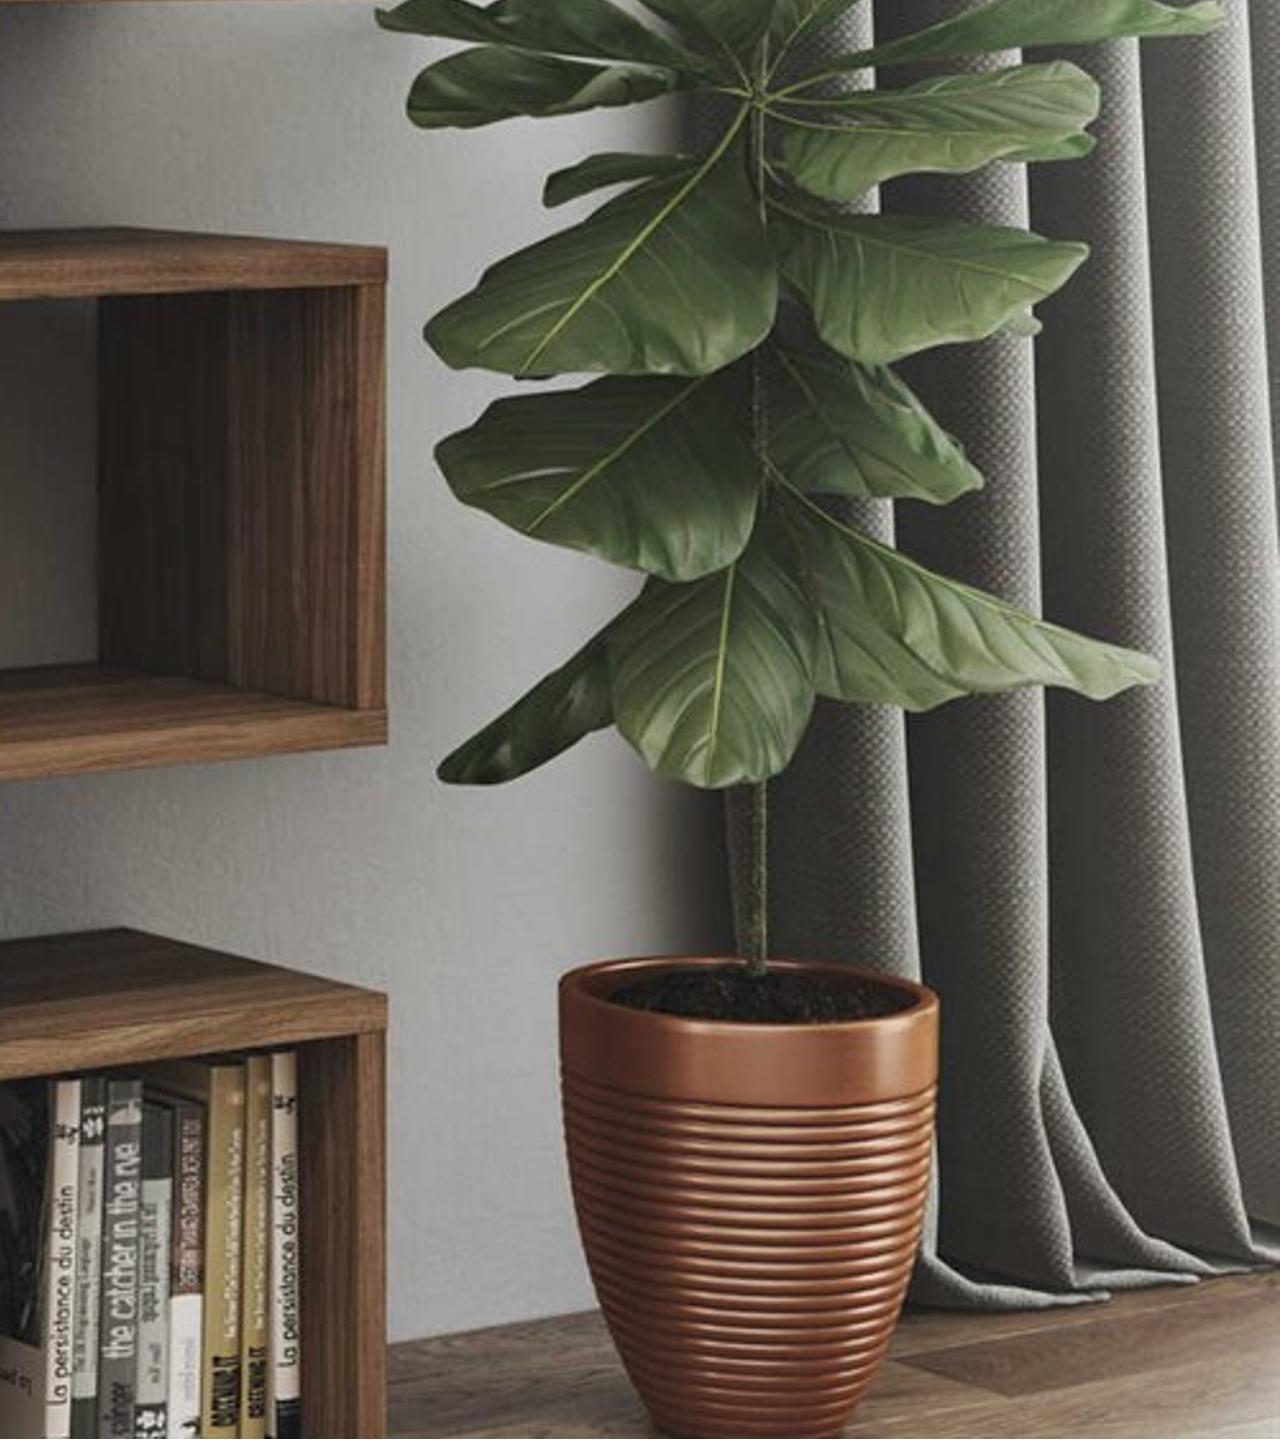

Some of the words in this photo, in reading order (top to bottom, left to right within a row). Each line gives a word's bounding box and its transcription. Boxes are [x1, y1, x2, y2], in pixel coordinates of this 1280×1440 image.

[113, 1142, 141, 1177] rye
[274, 1152, 297, 1207] destin
[51, 1184, 74, 1241] destin
[105, 1181, 139, 1215] the
[103, 1219, 138, 1240] in
[275, 1212, 297, 1236] du
[49, 1246, 73, 1270] du
[103, 1242, 138, 1320] catcher
[277, 1241, 300, 1341] persistance
[51, 1275, 73, 1379] persistance
[100, 1325, 136, 1359] the
[277, 1345, 297, 1368] La
[45, 1384, 68, 1406] La
